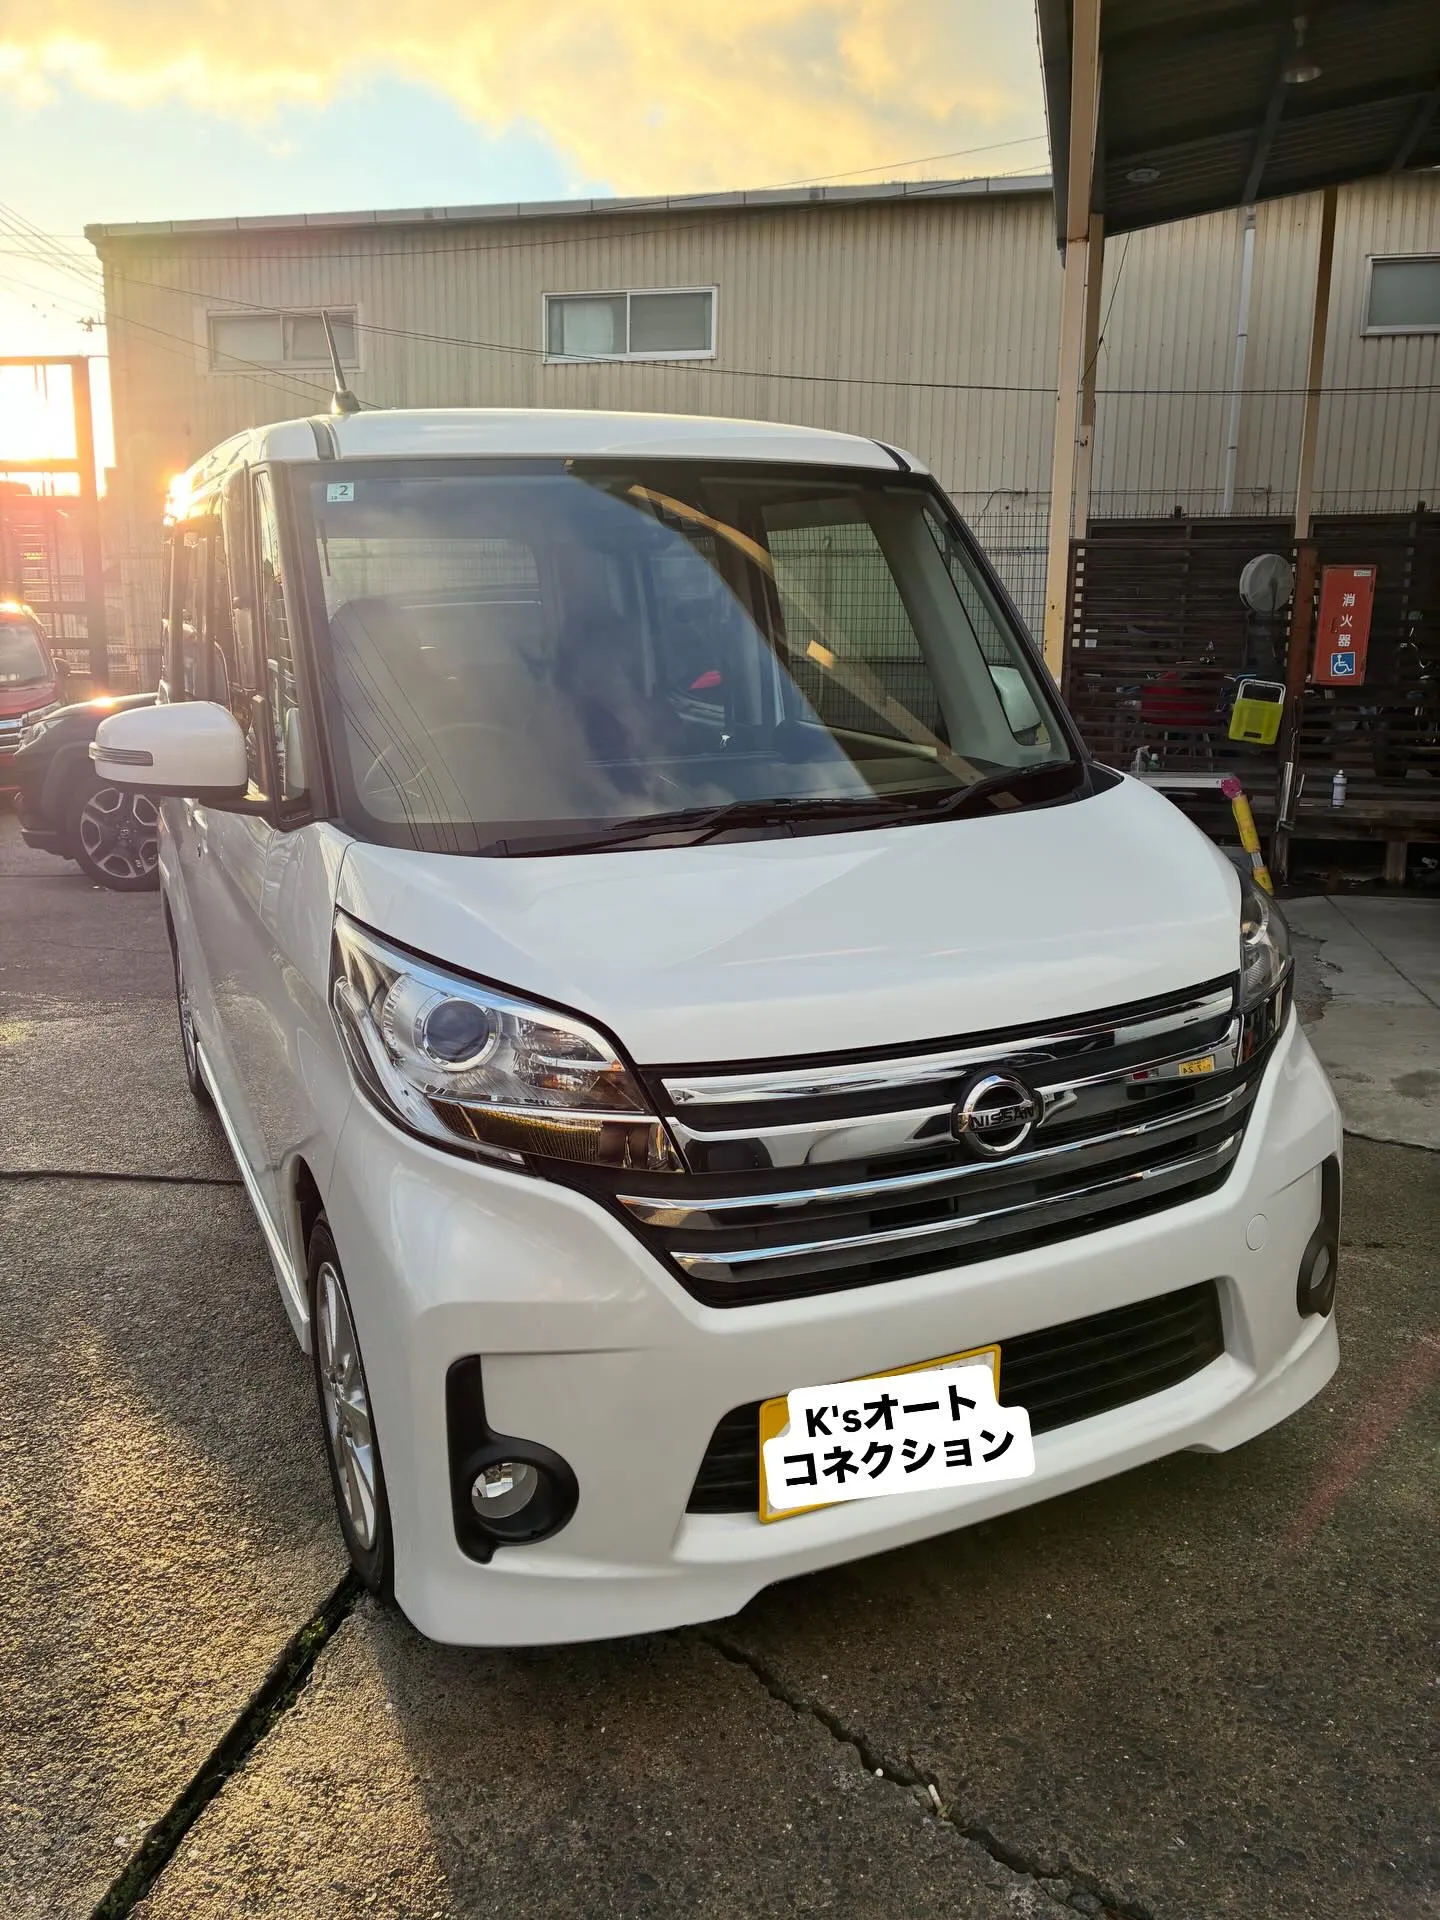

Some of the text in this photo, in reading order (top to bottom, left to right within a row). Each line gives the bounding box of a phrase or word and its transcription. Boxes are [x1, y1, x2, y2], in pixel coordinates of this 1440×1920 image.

[339, 485, 349, 496] 2
[1338, 593, 1356, 647] 消火器
[970, 1104, 1035, 1129] NISSAN
